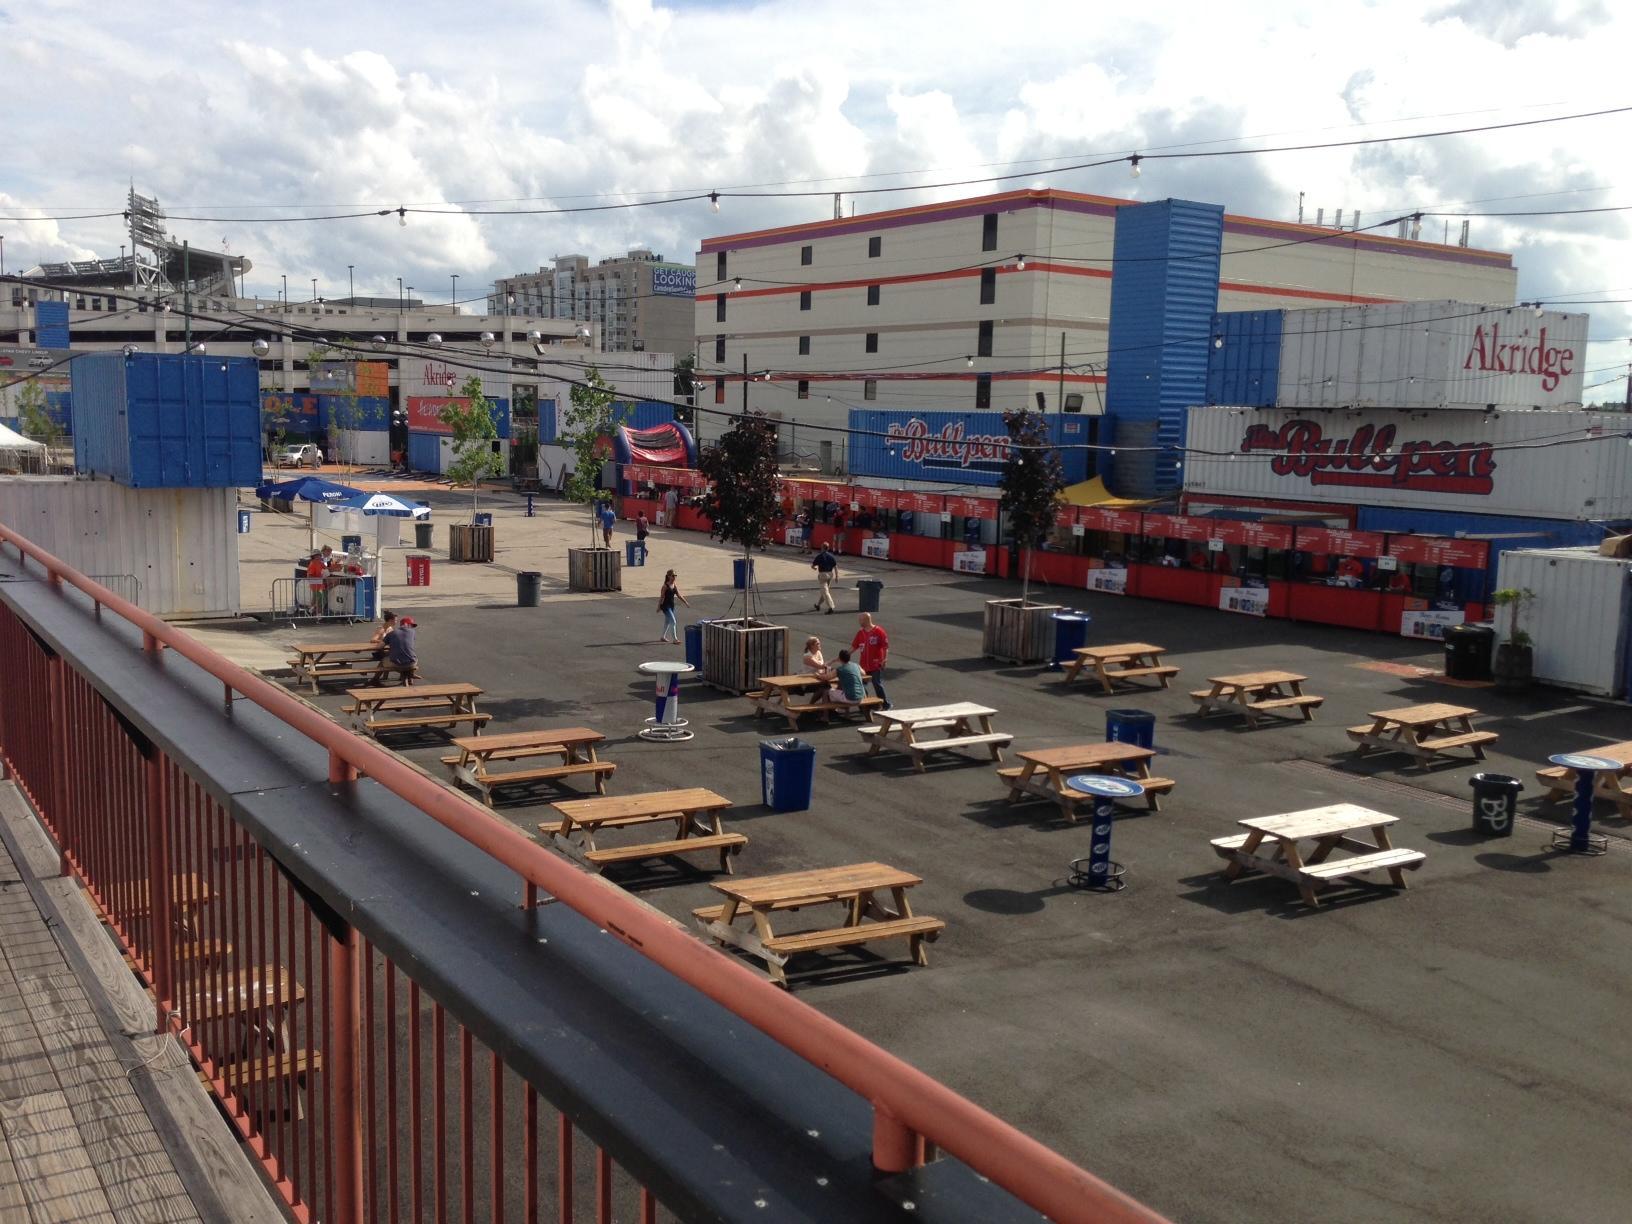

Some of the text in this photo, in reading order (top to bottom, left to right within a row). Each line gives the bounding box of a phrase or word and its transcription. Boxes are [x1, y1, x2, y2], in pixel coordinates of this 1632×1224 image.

[654, 267, 668, 275] GET
[1463, 321, 1574, 393] Akridge
[422, 362, 457, 390] Akridge
[1241, 419, 1497, 485] The Bullpen
[1481, 794, 1508, 831] BP
